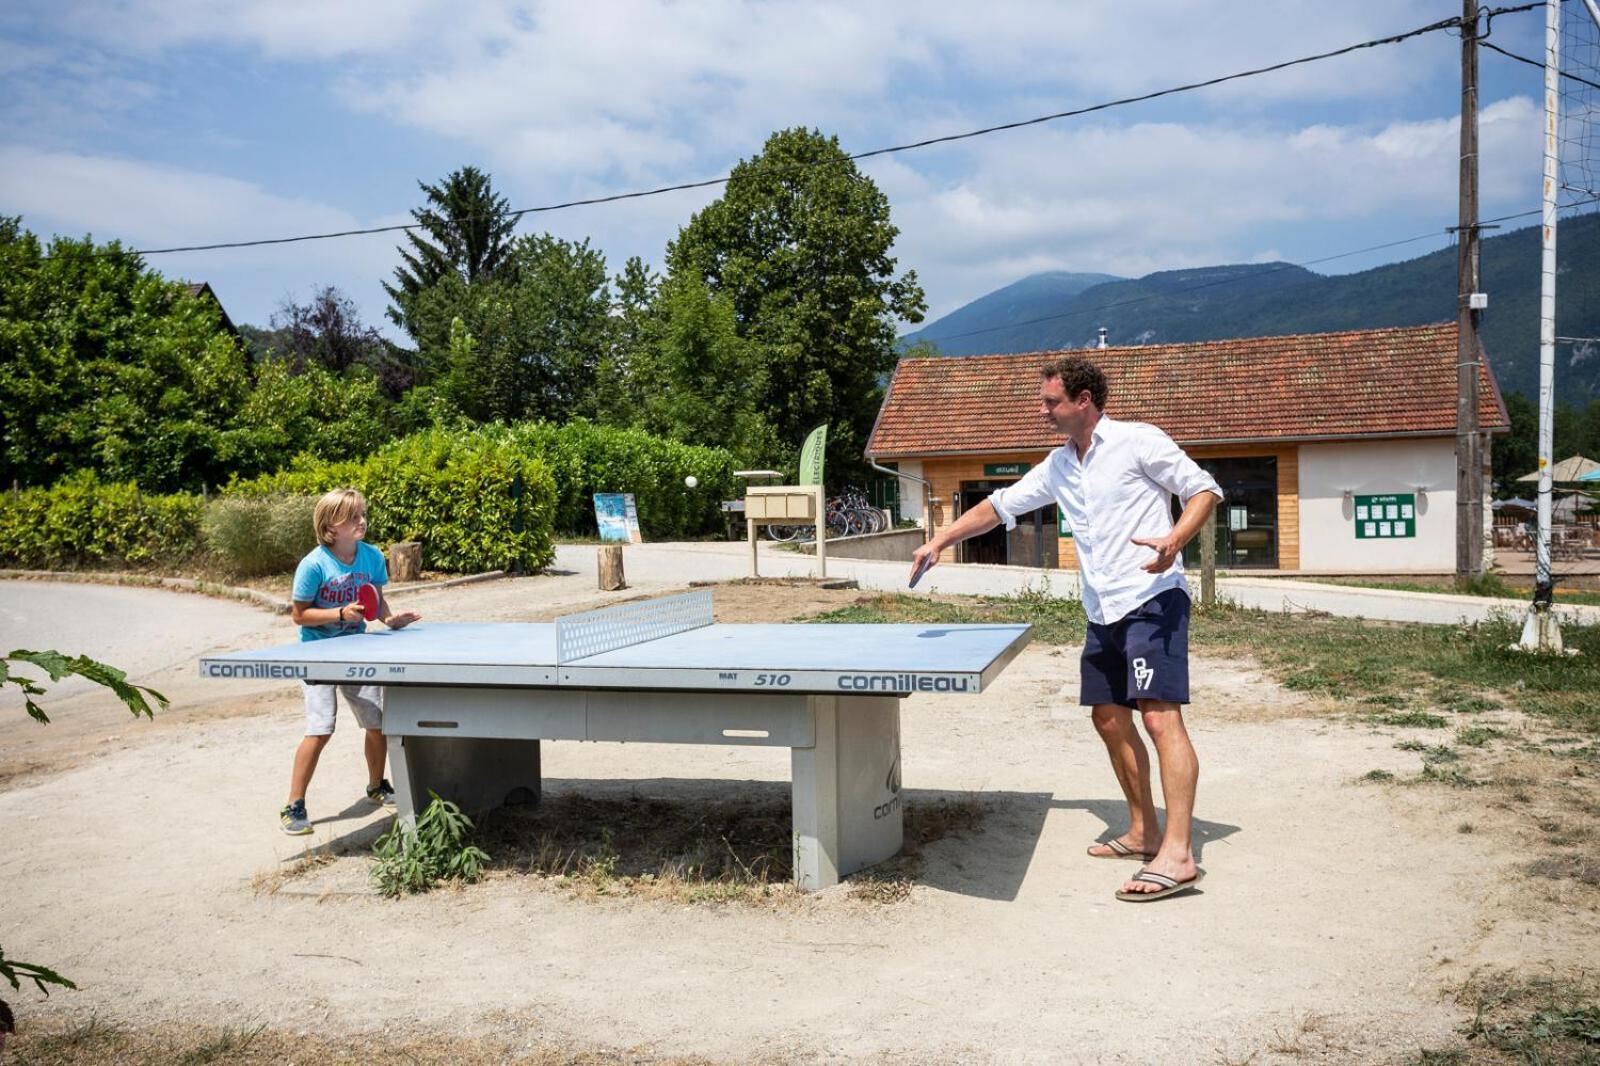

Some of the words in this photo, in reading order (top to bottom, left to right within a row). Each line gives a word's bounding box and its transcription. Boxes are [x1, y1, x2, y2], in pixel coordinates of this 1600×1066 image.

[209, 663, 308, 679] cornilleau
[345, 666, 377, 679] 510
[389, 666, 406, 674] MAT
[718, 672, 738, 681] MAT
[754, 674, 791, 687] 510
[837, 674, 968, 692] cornilleau
